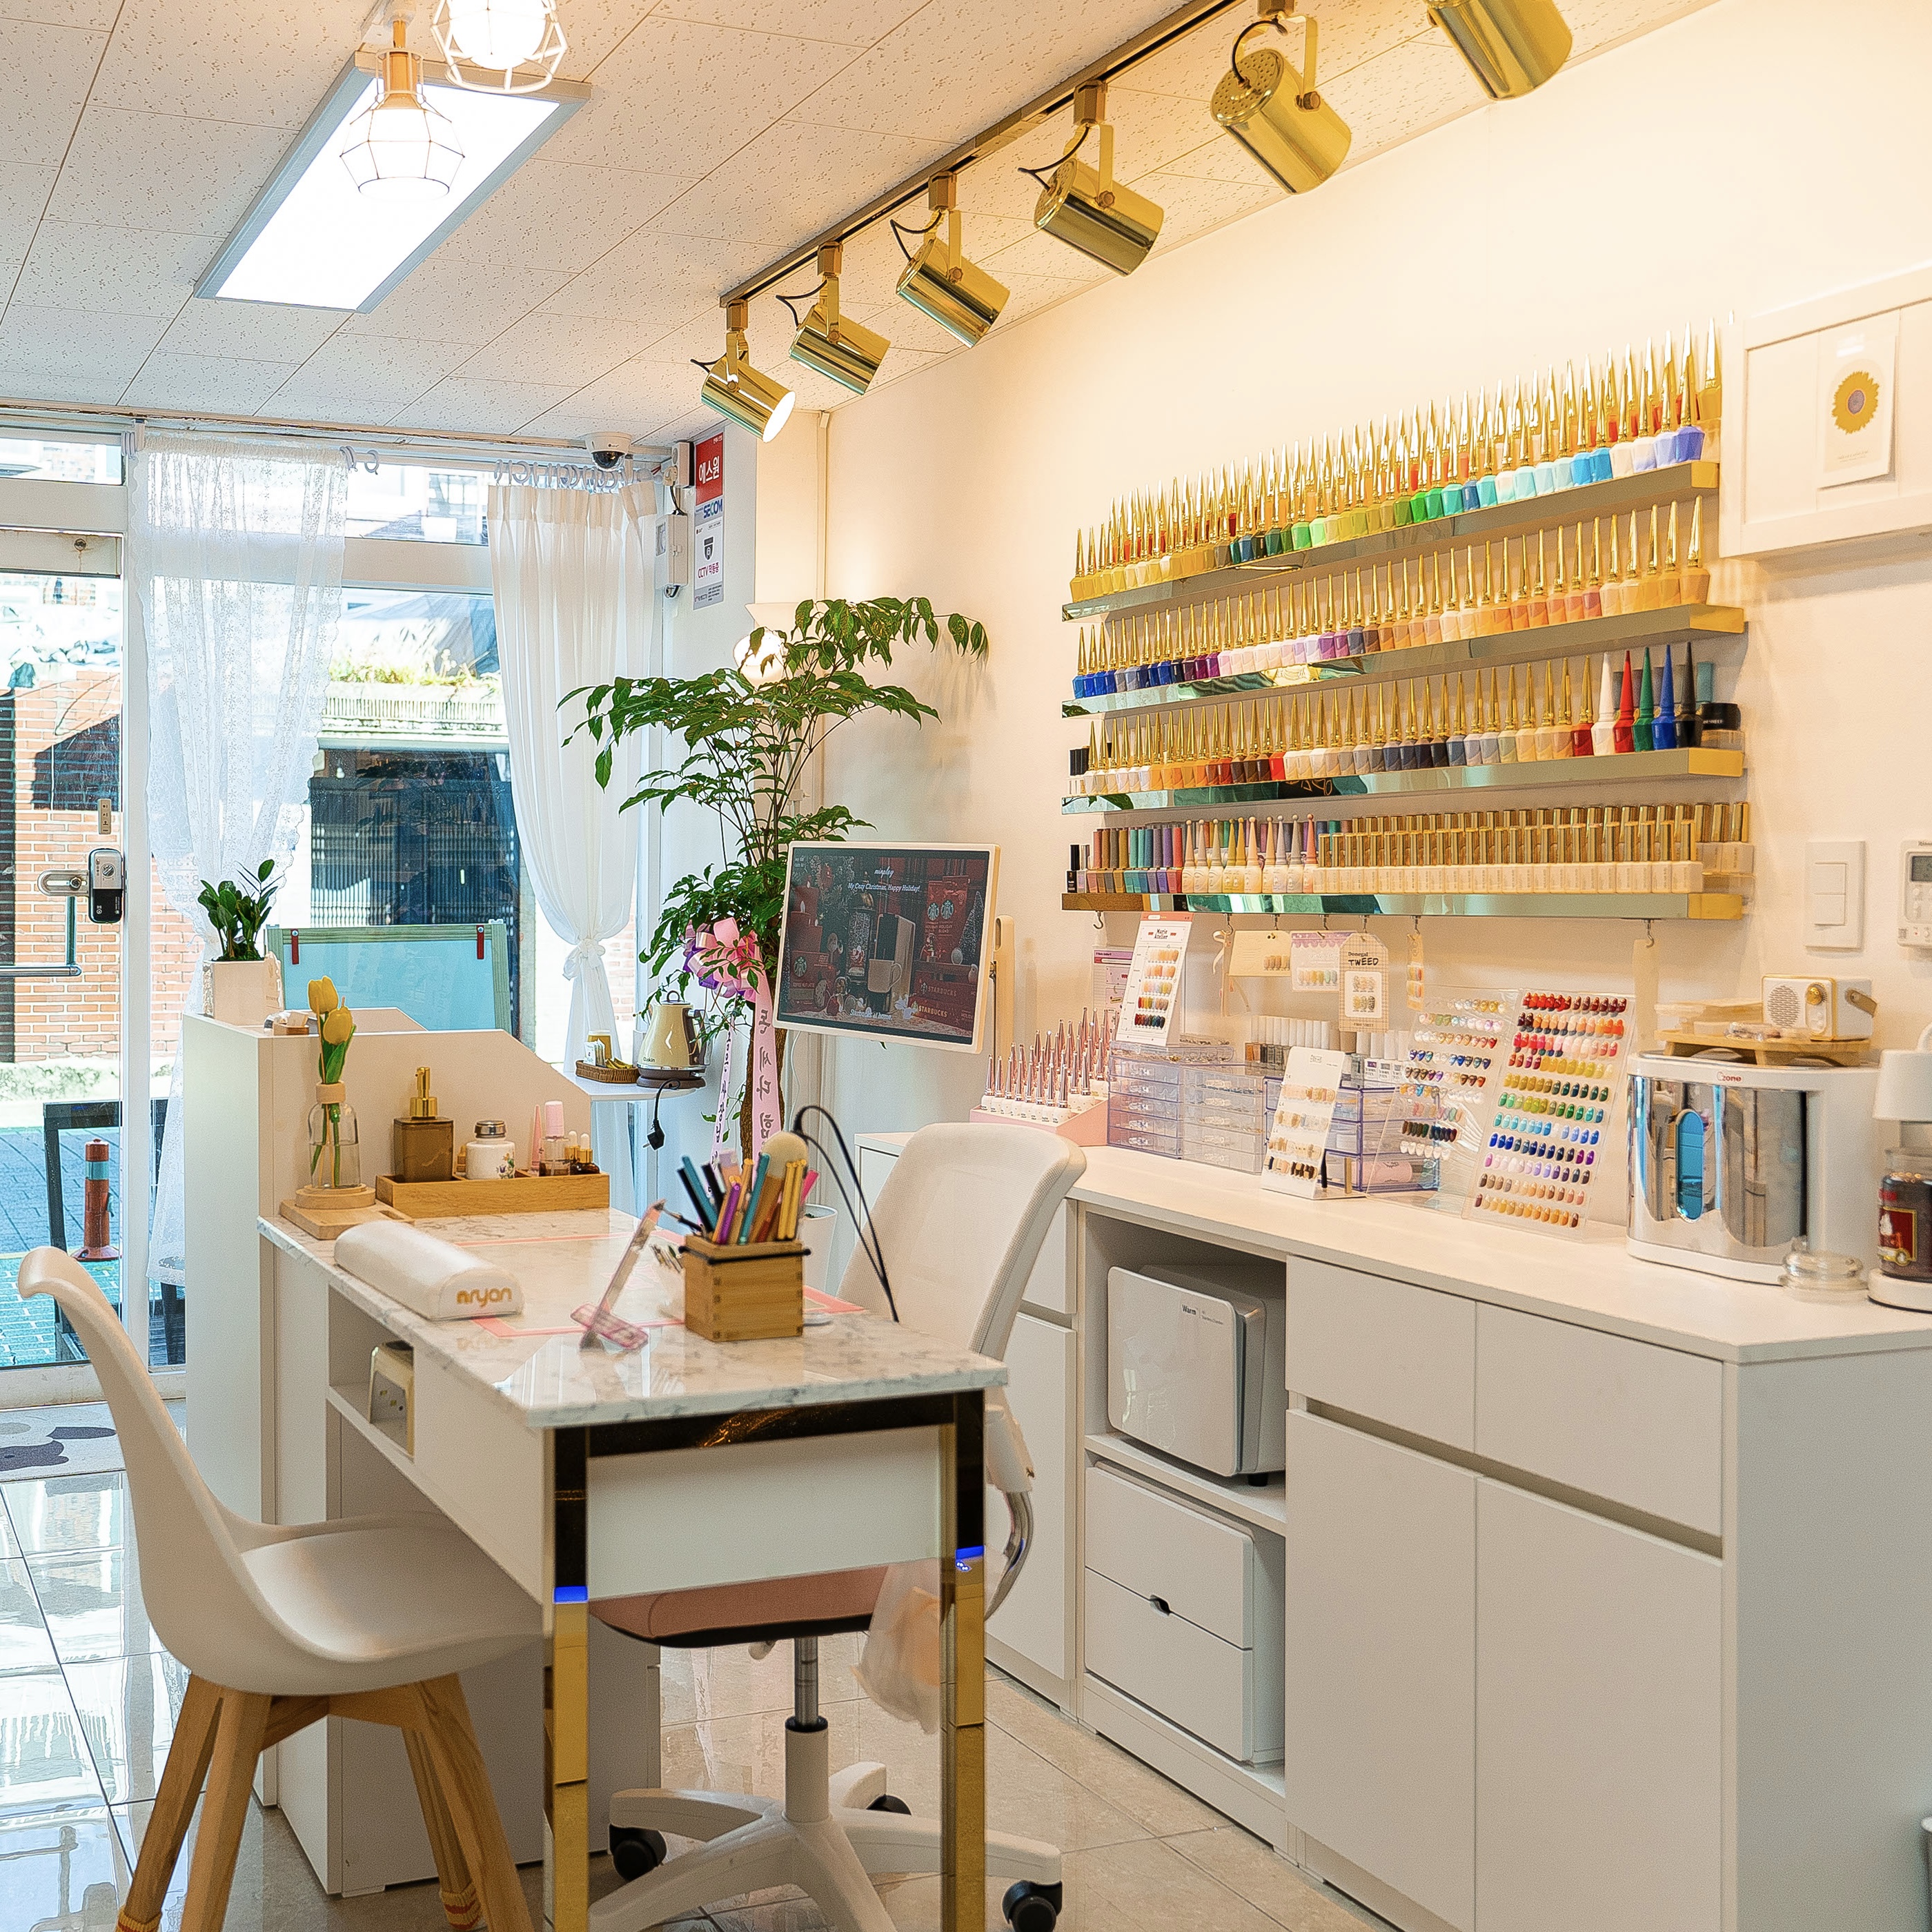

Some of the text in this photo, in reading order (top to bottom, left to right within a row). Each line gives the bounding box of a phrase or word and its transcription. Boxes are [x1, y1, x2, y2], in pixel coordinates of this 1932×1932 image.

[699, 455, 720, 484] 에스원
[703, 498, 723, 518] SECOM
[698, 562, 720, 578] CCTV 작동중
[855, 883, 865, 891] Cozy
[888, 884, 902, 892] Happy
[902, 885, 920, 893] Holiday!
[1348, 958, 1379, 966] TWEED
[928, 987, 957, 996] STARBUCKS
[918, 1005, 947, 1018] STARBUCKS
[1181, 1304, 1196, 1315] Warm
